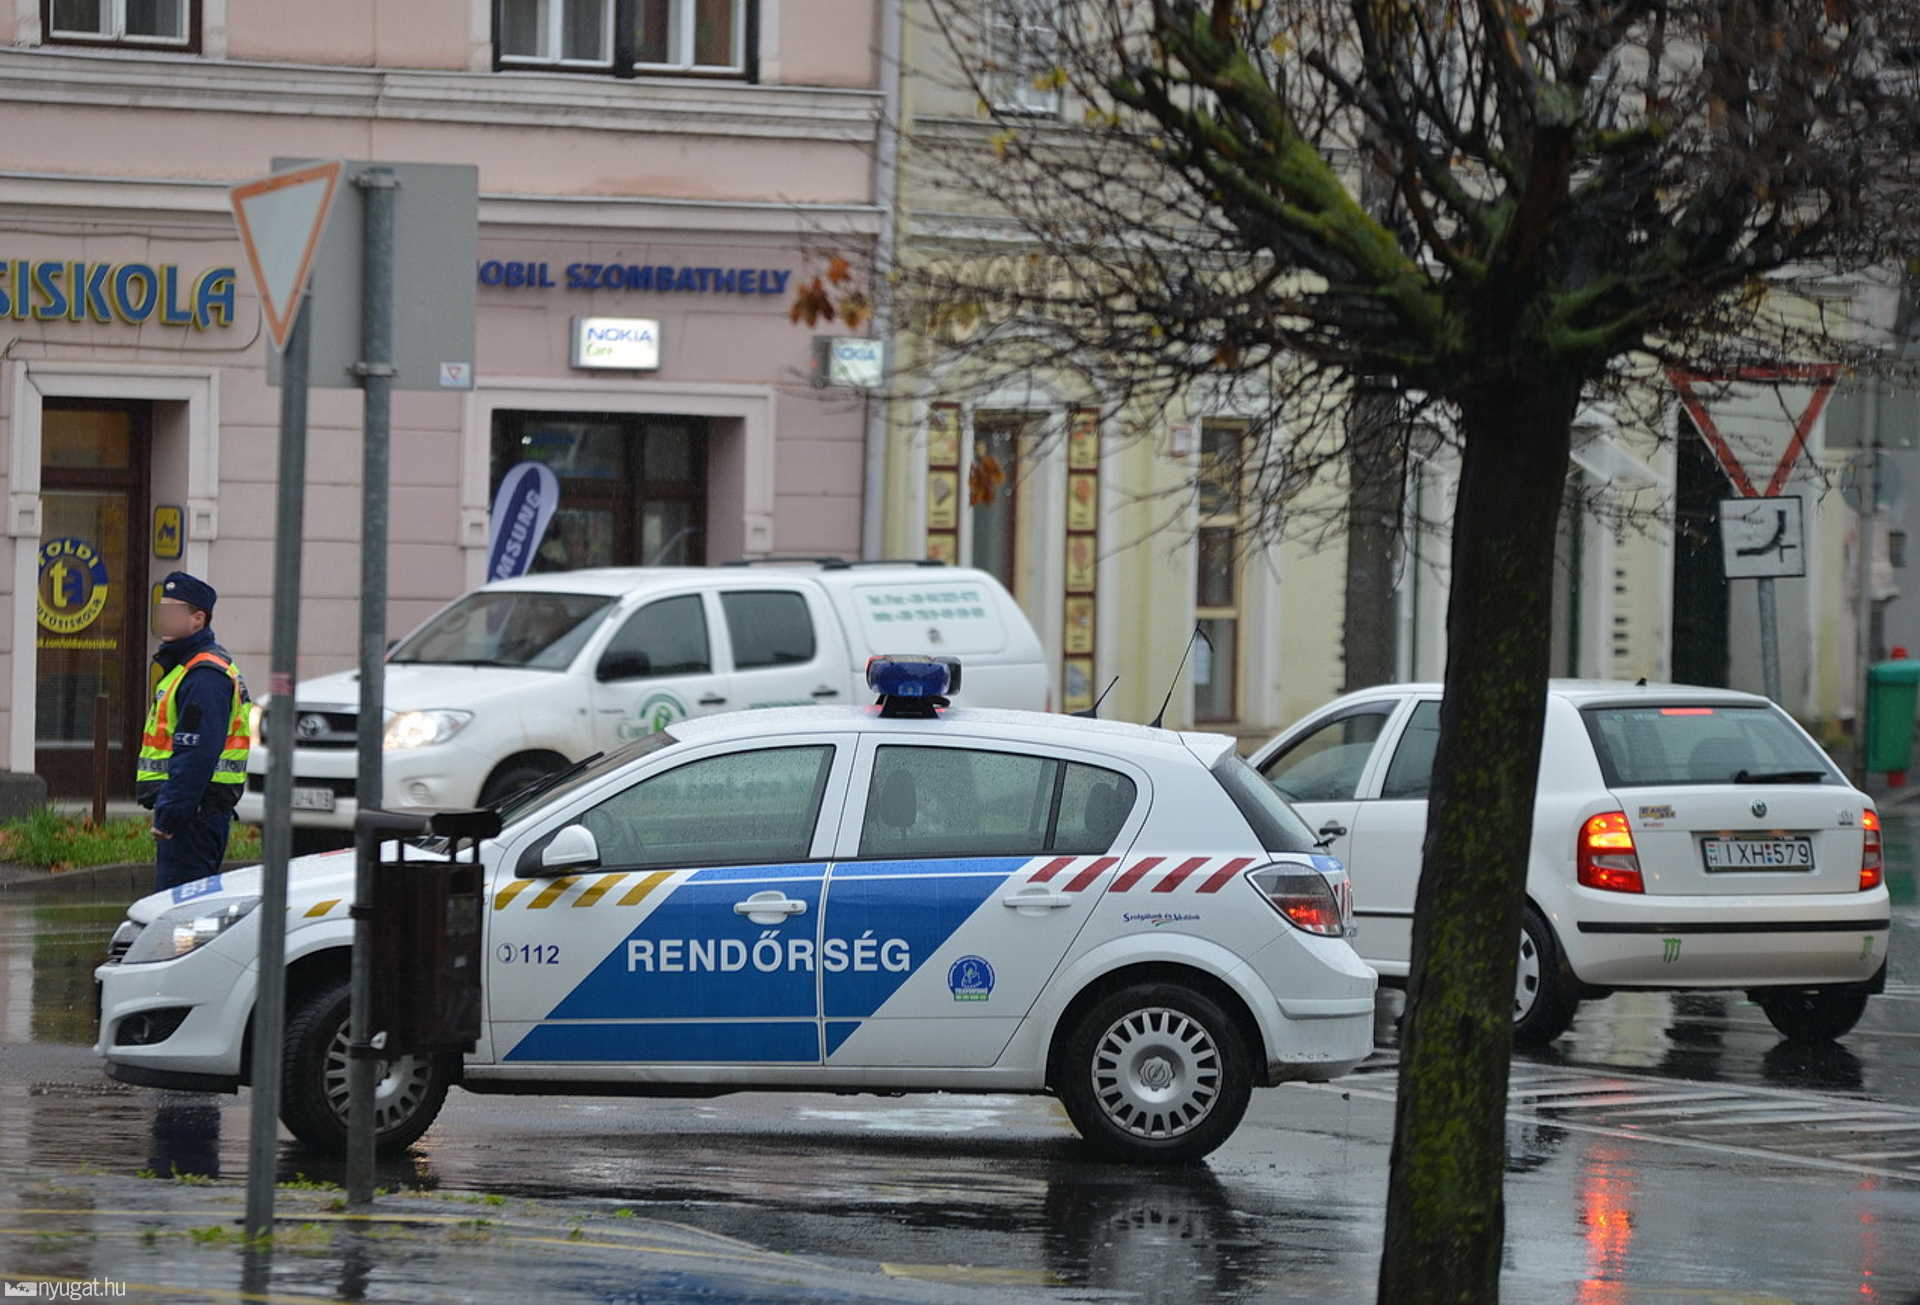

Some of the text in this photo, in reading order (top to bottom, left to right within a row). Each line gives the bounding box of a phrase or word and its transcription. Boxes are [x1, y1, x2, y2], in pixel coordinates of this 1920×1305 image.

[477, 260, 792, 296] OBIL SZOMBATHELY
[586, 327, 652, 342] NOKIA
[492, 489, 541, 581] MSUNG
[519, 944, 560, 965] 112
[626, 930, 911, 973] RENDŐRSÉG
